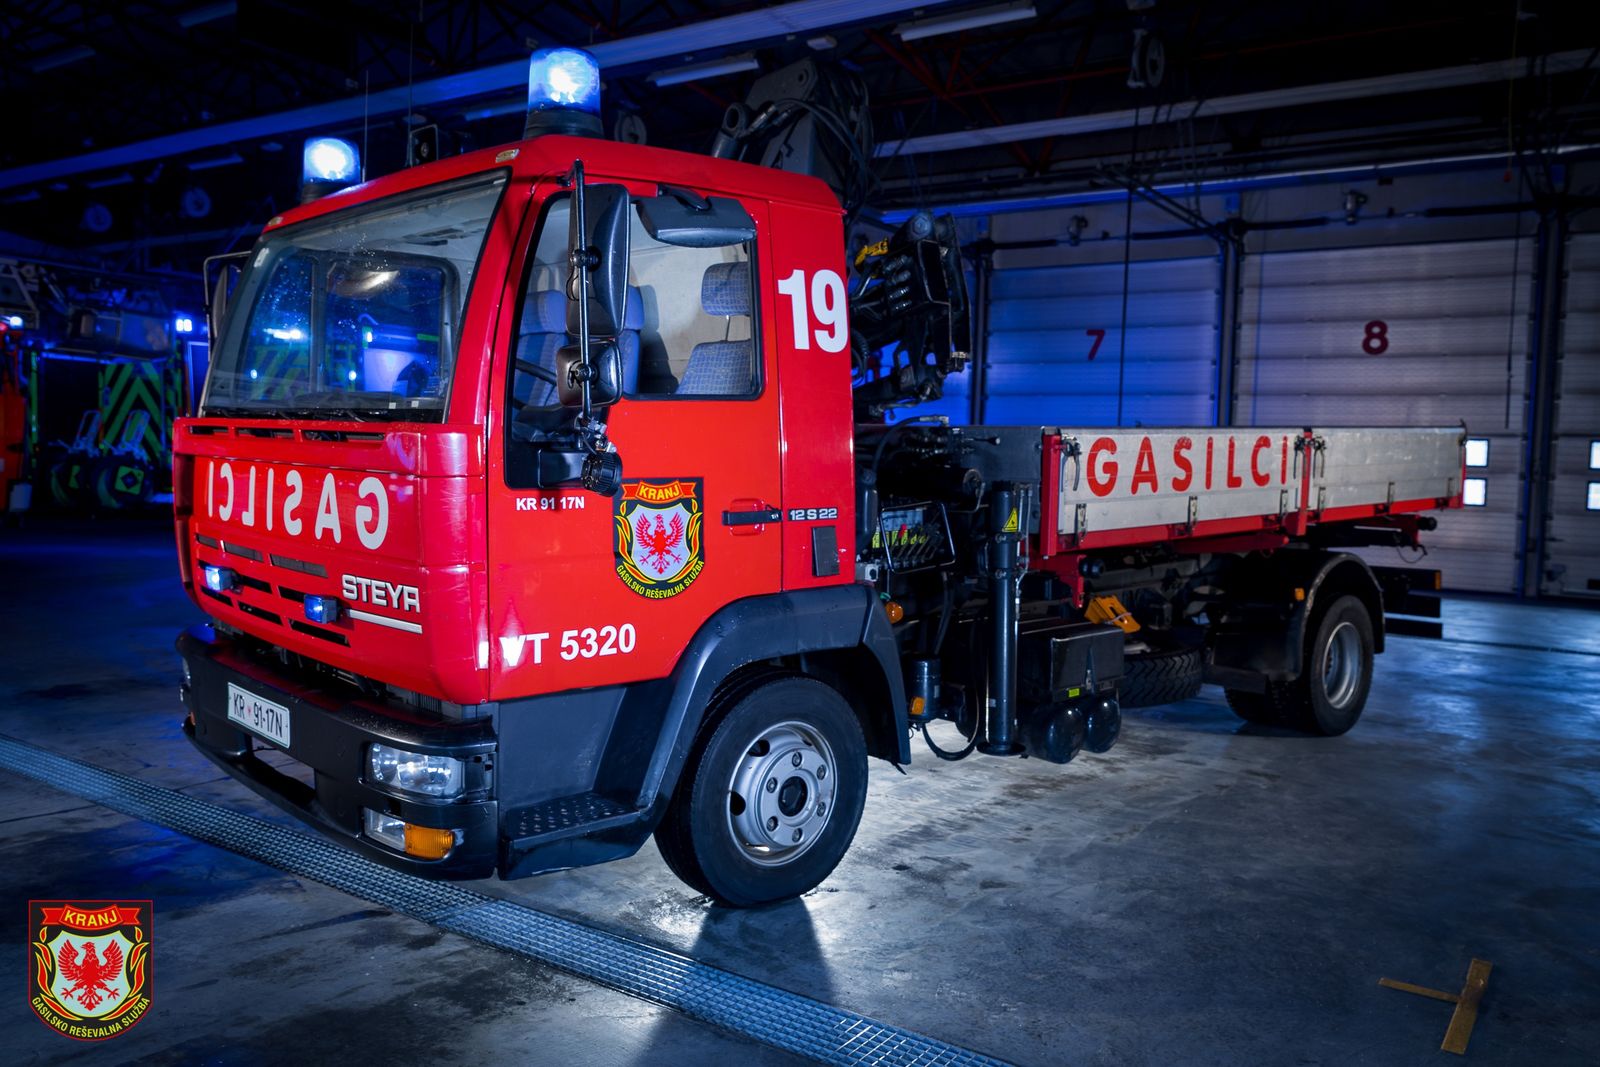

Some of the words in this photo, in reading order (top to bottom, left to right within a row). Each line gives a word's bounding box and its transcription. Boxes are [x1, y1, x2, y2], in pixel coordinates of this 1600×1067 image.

[777, 268, 848, 353] 19
[1086, 329, 1105, 360] 7
[1361, 320, 1389, 355] 8
[1086, 436, 1288, 497] GASILCI
[516, 497, 537, 510] KR
[540, 497, 556, 510] 91
[560, 496, 585, 509] 17N
[639, 484, 680, 500] KRANJ
[790, 509, 805, 520] 12
[806, 508, 817, 520] S
[819, 507, 838, 519] 22
[341, 573, 421, 613] STEYR
[616, 564, 645, 595] GASILSKO
[645, 583, 685, 599] REŠEVALNA
[685, 560, 705, 587] SLUŽBA
[560, 623, 636, 661] 5320
[233, 692, 245, 720] KR
[253, 701, 283, 738] 91-17N
